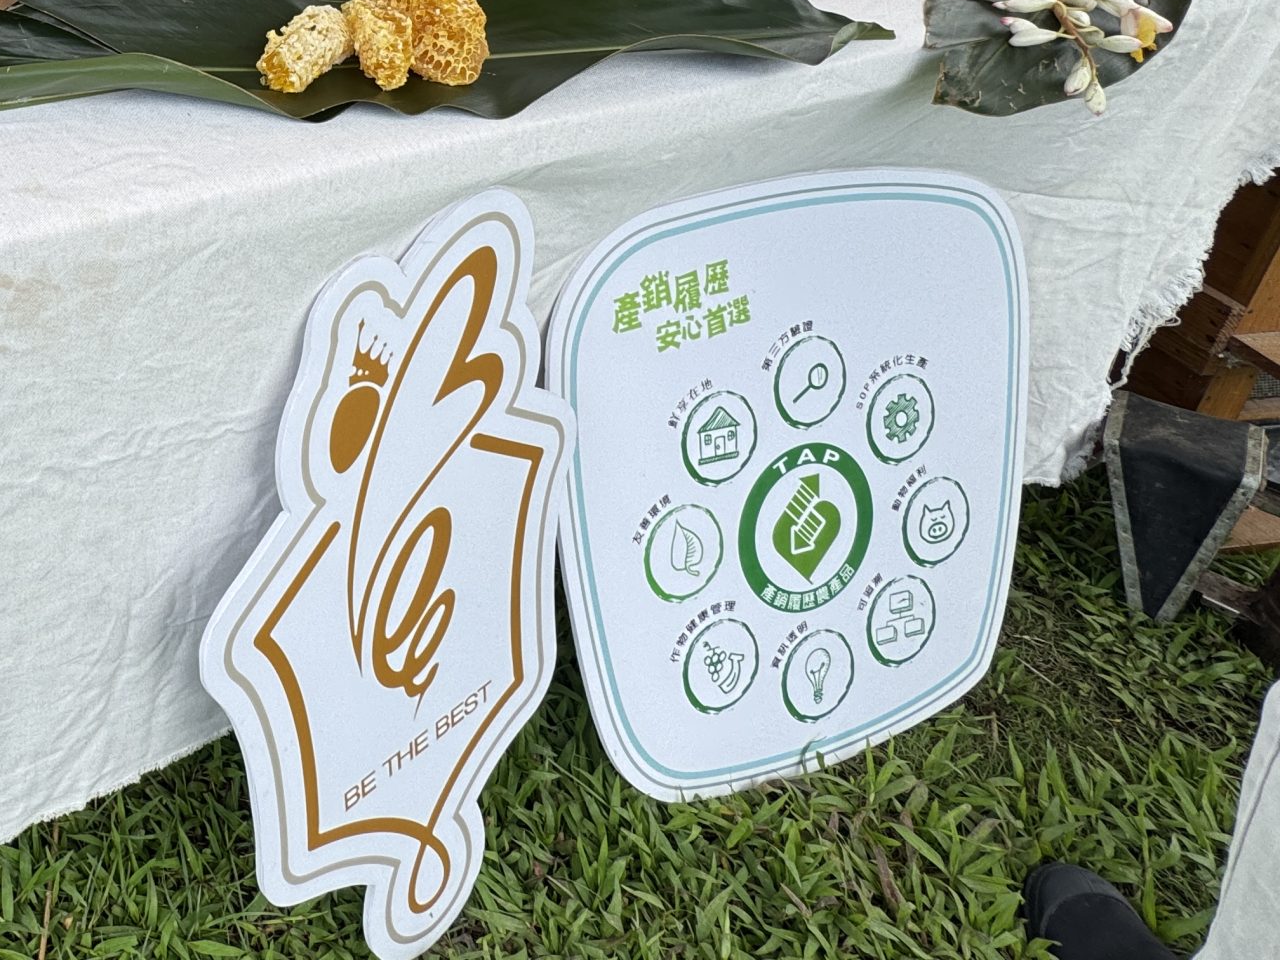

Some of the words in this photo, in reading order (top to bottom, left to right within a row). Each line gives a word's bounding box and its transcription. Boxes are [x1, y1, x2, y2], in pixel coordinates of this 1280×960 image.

[612, 258, 730, 334] 產銷履歷
[656, 294, 752, 353] 安心首選
[761, 319, 814, 372] 第三方驗證
[772, 447, 841, 476] TAP
[632, 494, 672, 545] 友善環境
[760, 563, 856, 611] 產銷履歷農產品
[670, 600, 737, 664] 作物健康管理
[343, 769, 377, 813] BE
[382, 728, 430, 778] THE
[434, 679, 493, 741] BEST
